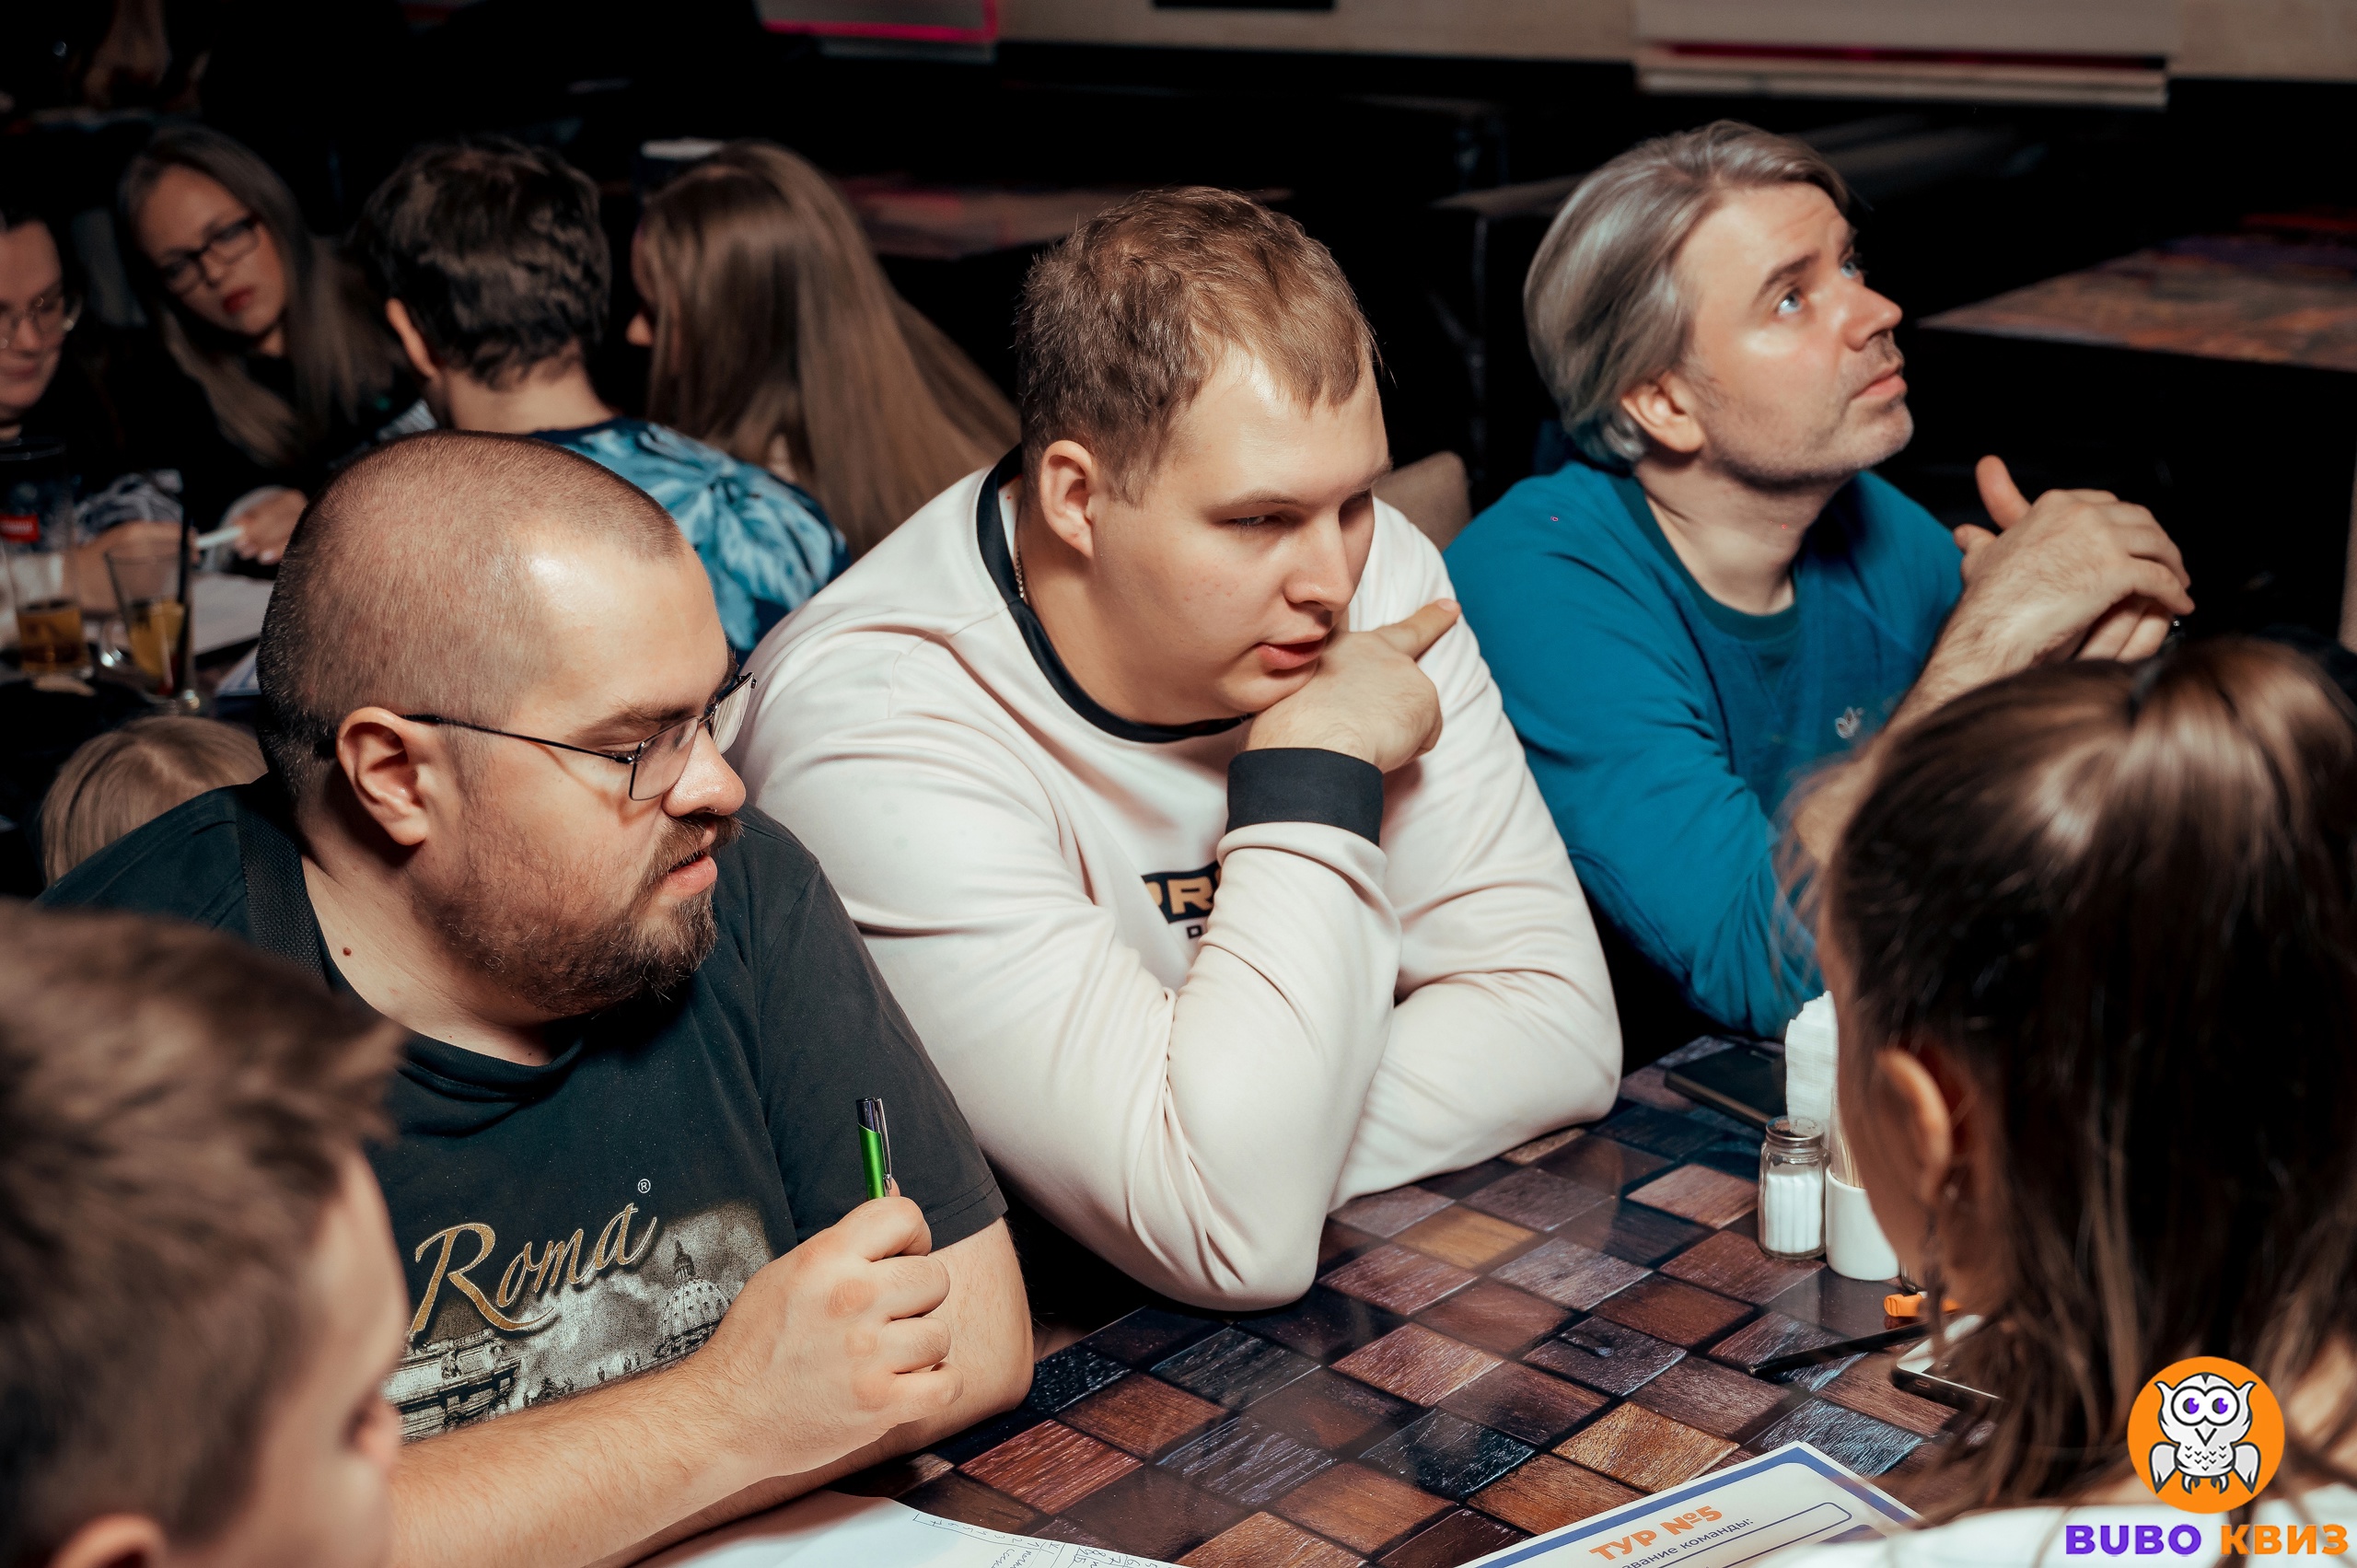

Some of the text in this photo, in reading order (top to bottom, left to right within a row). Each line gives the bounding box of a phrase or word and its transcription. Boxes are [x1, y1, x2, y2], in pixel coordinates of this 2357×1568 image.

[409, 1202, 657, 1339] Roma
[1588, 1529, 1657, 1561] ТУР
[1679, 1518, 1754, 1550] команды:
